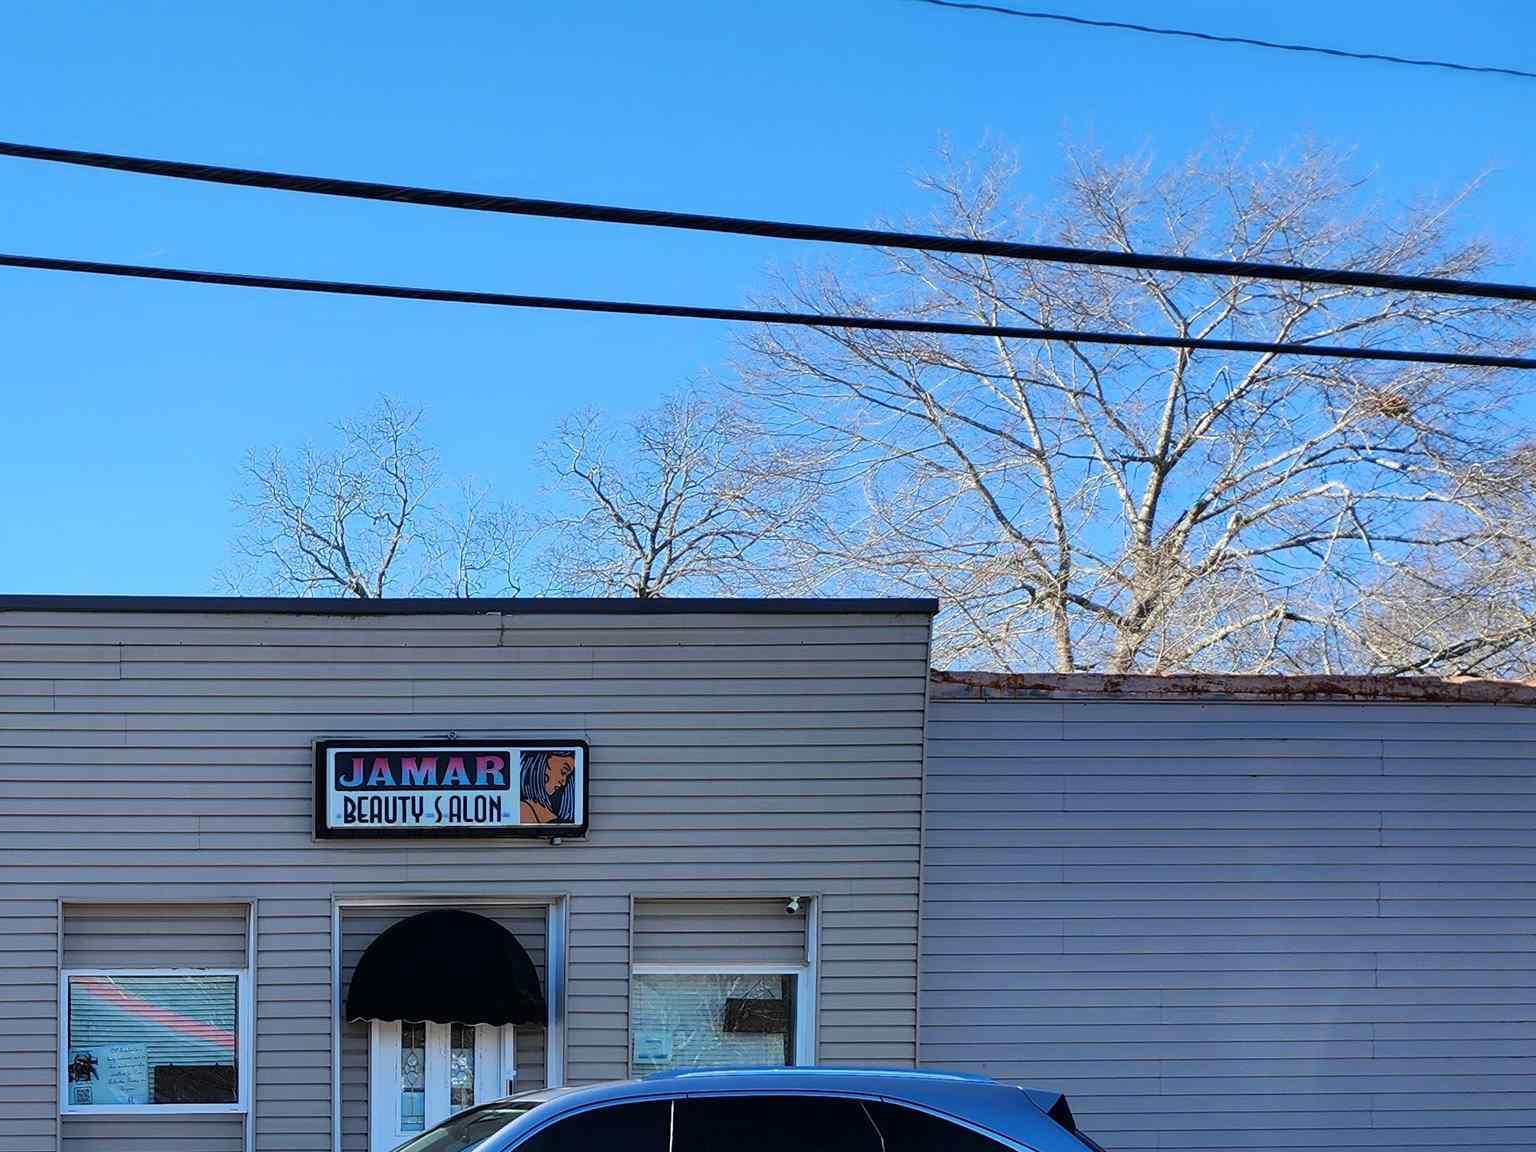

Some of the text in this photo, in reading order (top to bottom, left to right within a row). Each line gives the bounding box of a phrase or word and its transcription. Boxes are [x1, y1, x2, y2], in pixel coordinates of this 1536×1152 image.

[339, 755, 508, 787] JAMAR
[343, 795, 502, 824] BEAUTY SALON
